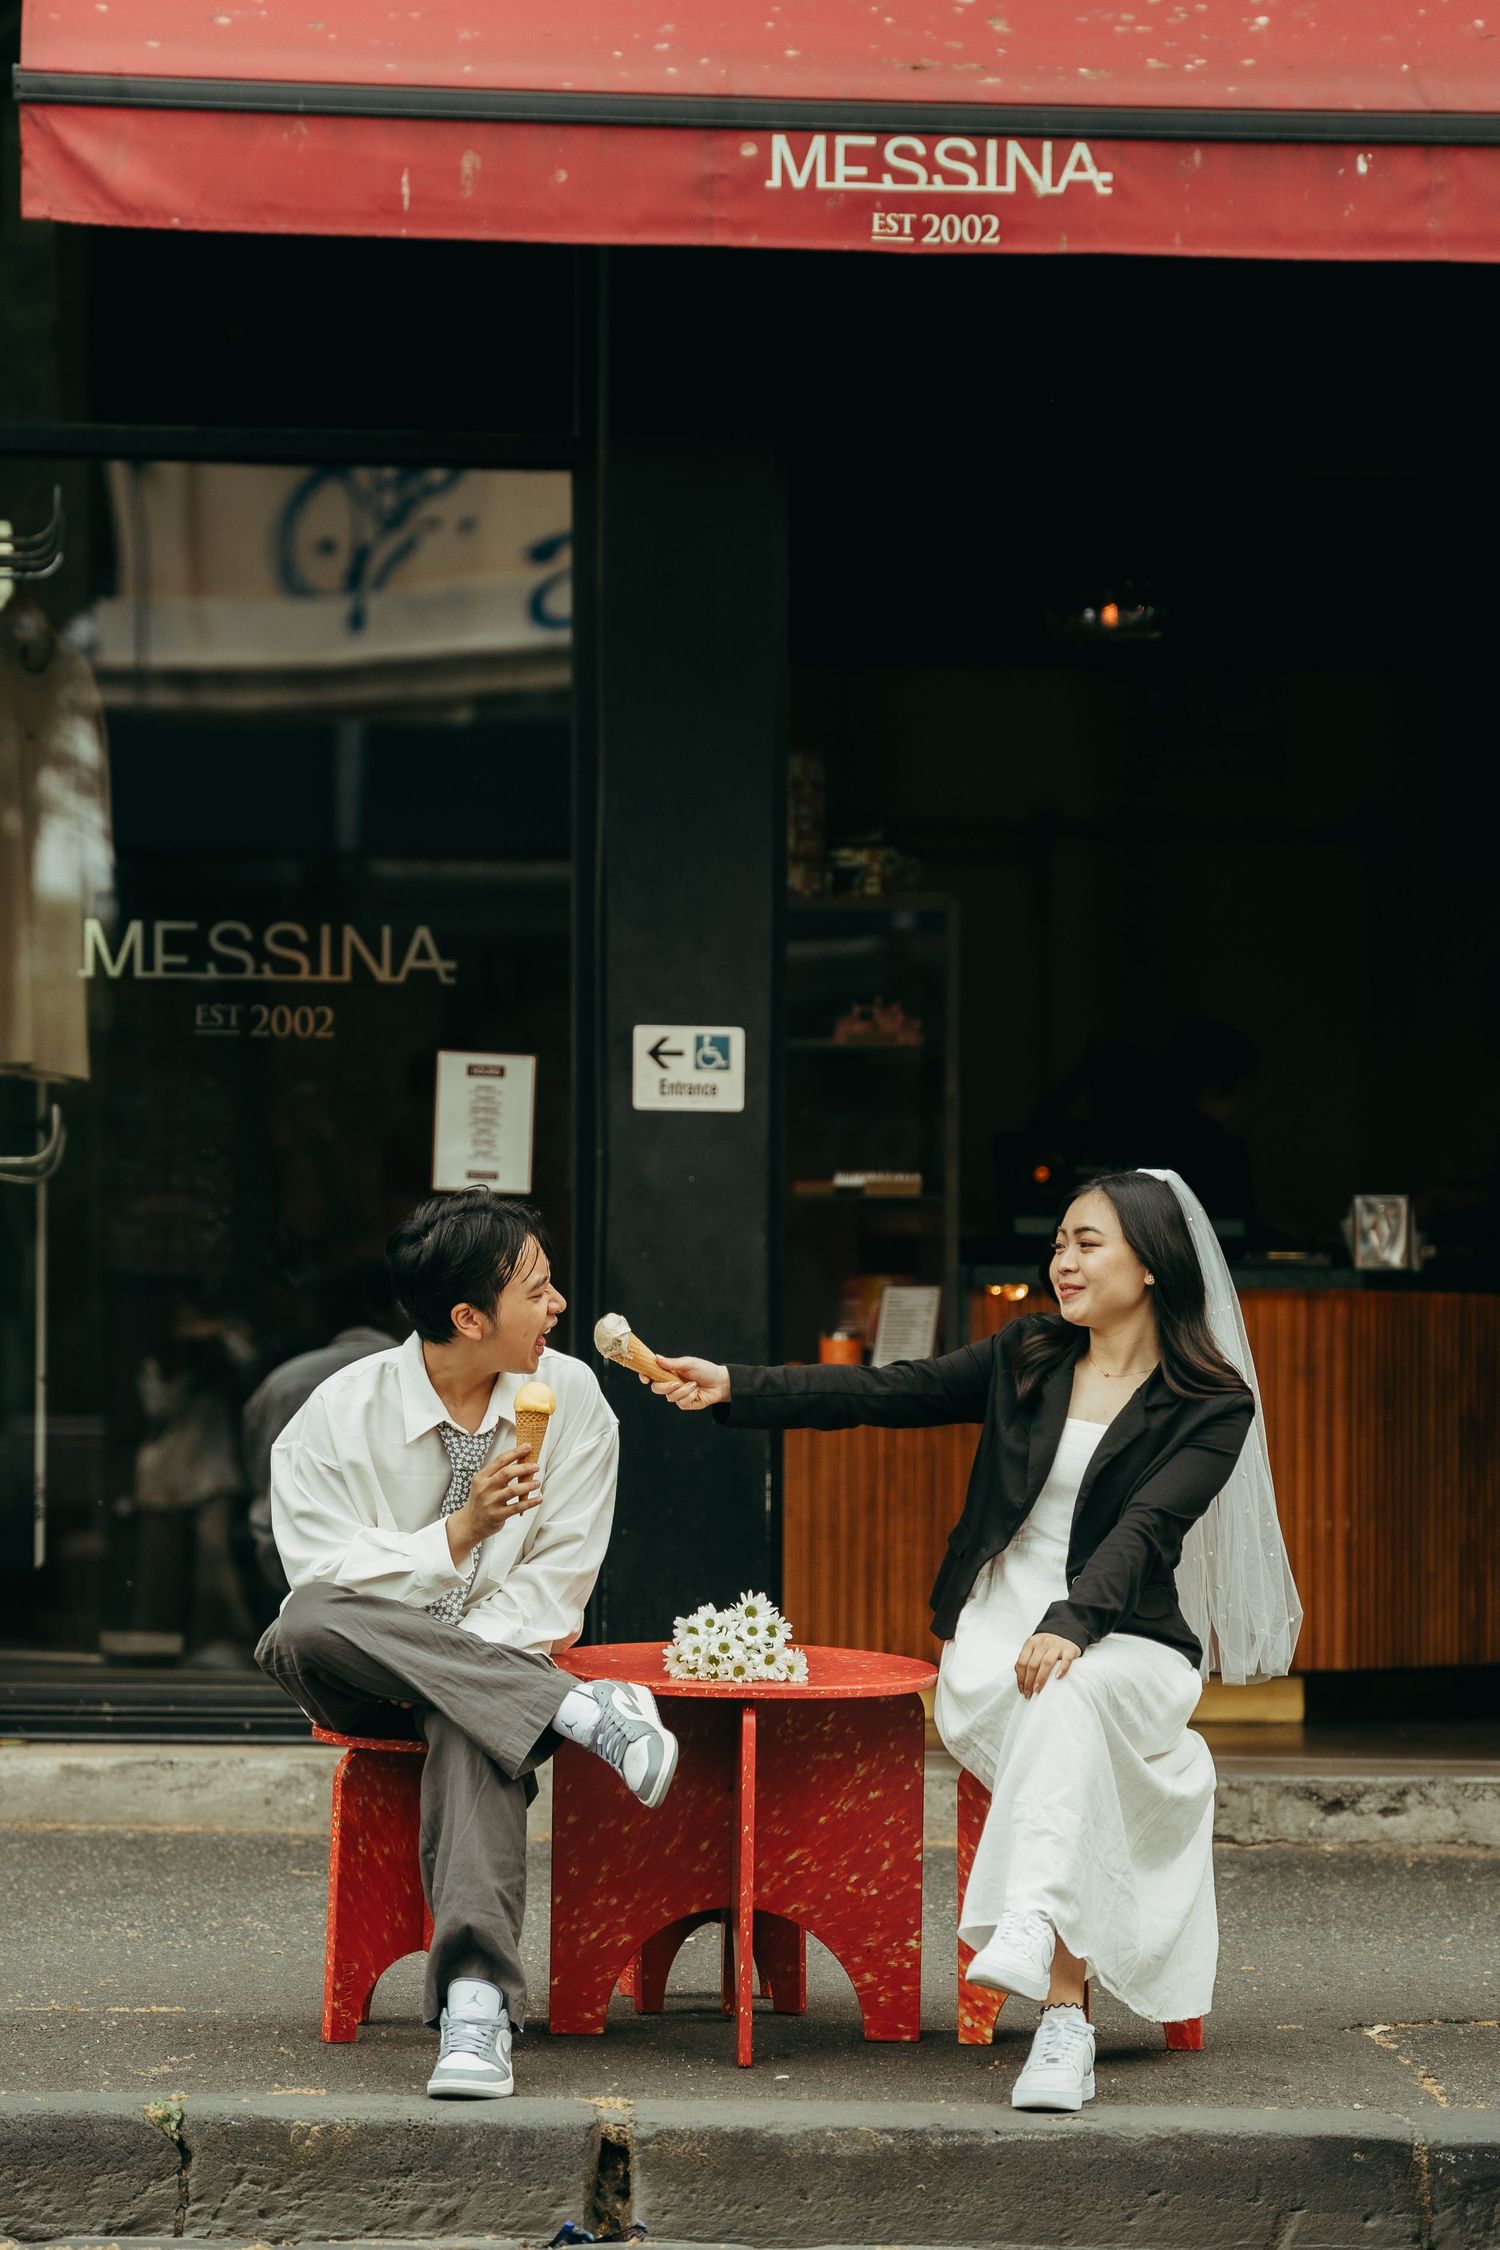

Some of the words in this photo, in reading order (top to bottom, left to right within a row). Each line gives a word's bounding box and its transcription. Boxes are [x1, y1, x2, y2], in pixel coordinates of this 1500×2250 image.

[765, 134, 1114, 198] MESSINA
[871, 211, 916, 242] EST
[920, 213, 1001, 244] 2002
[77, 917, 457, 985] MESSINA
[194, 1003, 242, 1036] EST
[249, 1004, 336, 1040] 2002
[659, 1078, 718, 1097] Entrance
